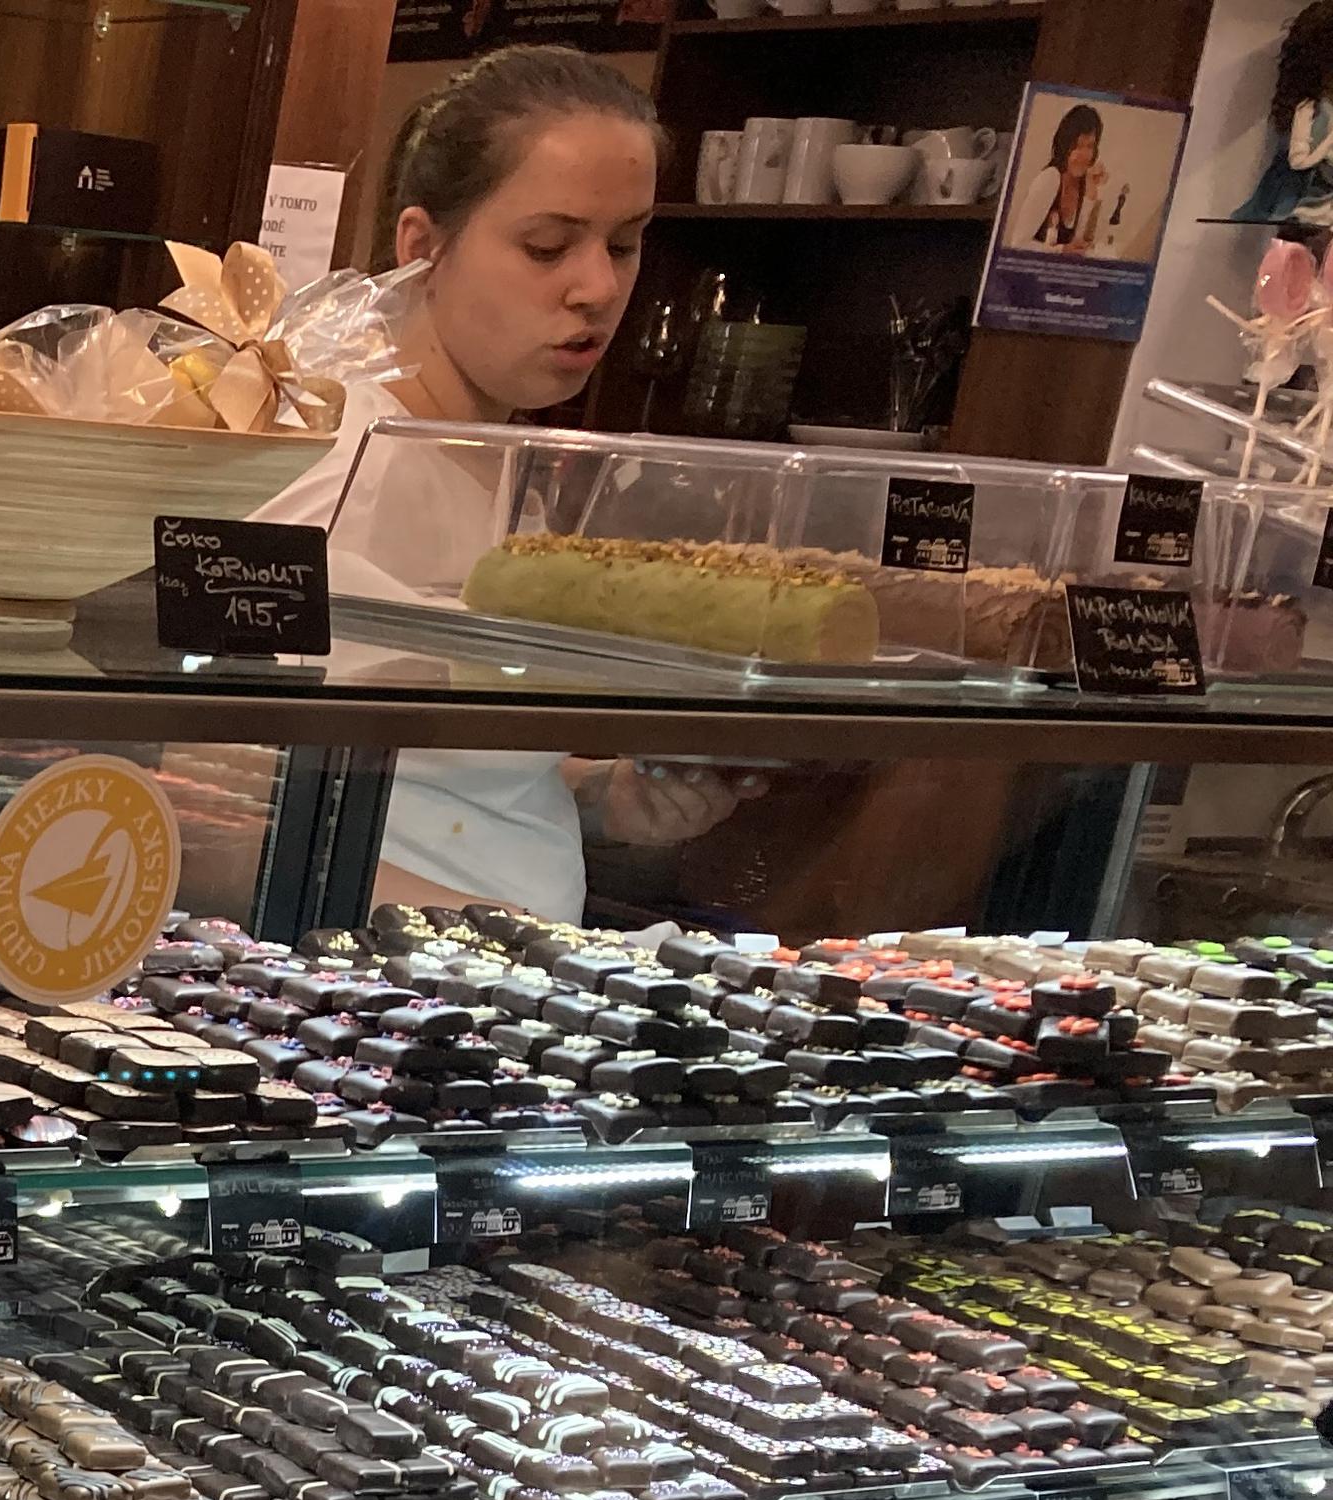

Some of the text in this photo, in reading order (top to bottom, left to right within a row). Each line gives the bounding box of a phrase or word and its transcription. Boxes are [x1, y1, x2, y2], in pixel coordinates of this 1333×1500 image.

[279, 196, 318, 212] TOMTO
[195, 555, 315, 588] KORNOUT
[15, 777, 114, 841] HEZKY
[80, 810, 164, 981] JIHOČESKY
